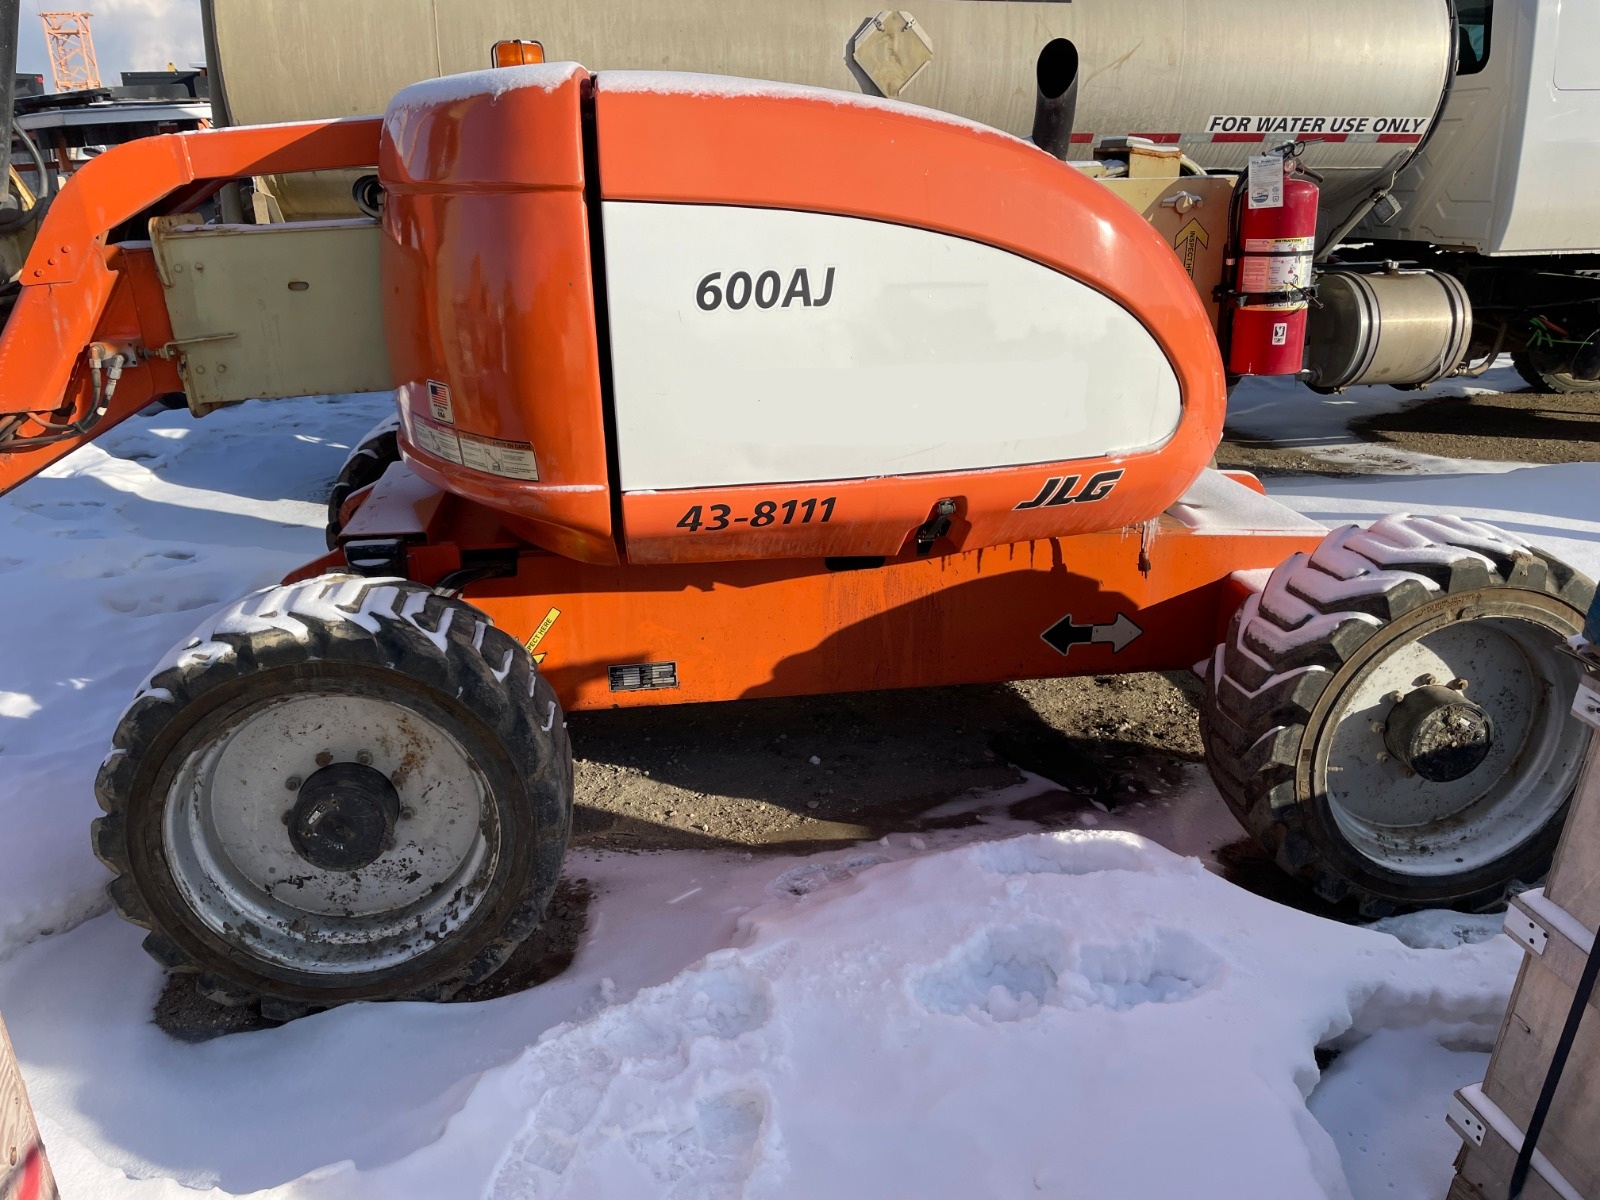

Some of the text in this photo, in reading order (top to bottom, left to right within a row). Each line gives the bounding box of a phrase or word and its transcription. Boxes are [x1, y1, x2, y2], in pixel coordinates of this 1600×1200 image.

[1209, 116, 1426, 133] FOR WATER USE ONLY
[1187, 230, 1196, 262] INSPECT
[696, 267, 836, 311] 600AJ
[1012, 468, 1126, 511] JLG
[676, 497, 837, 532] 43-8111
[526, 618, 552, 651] PECT HERE
